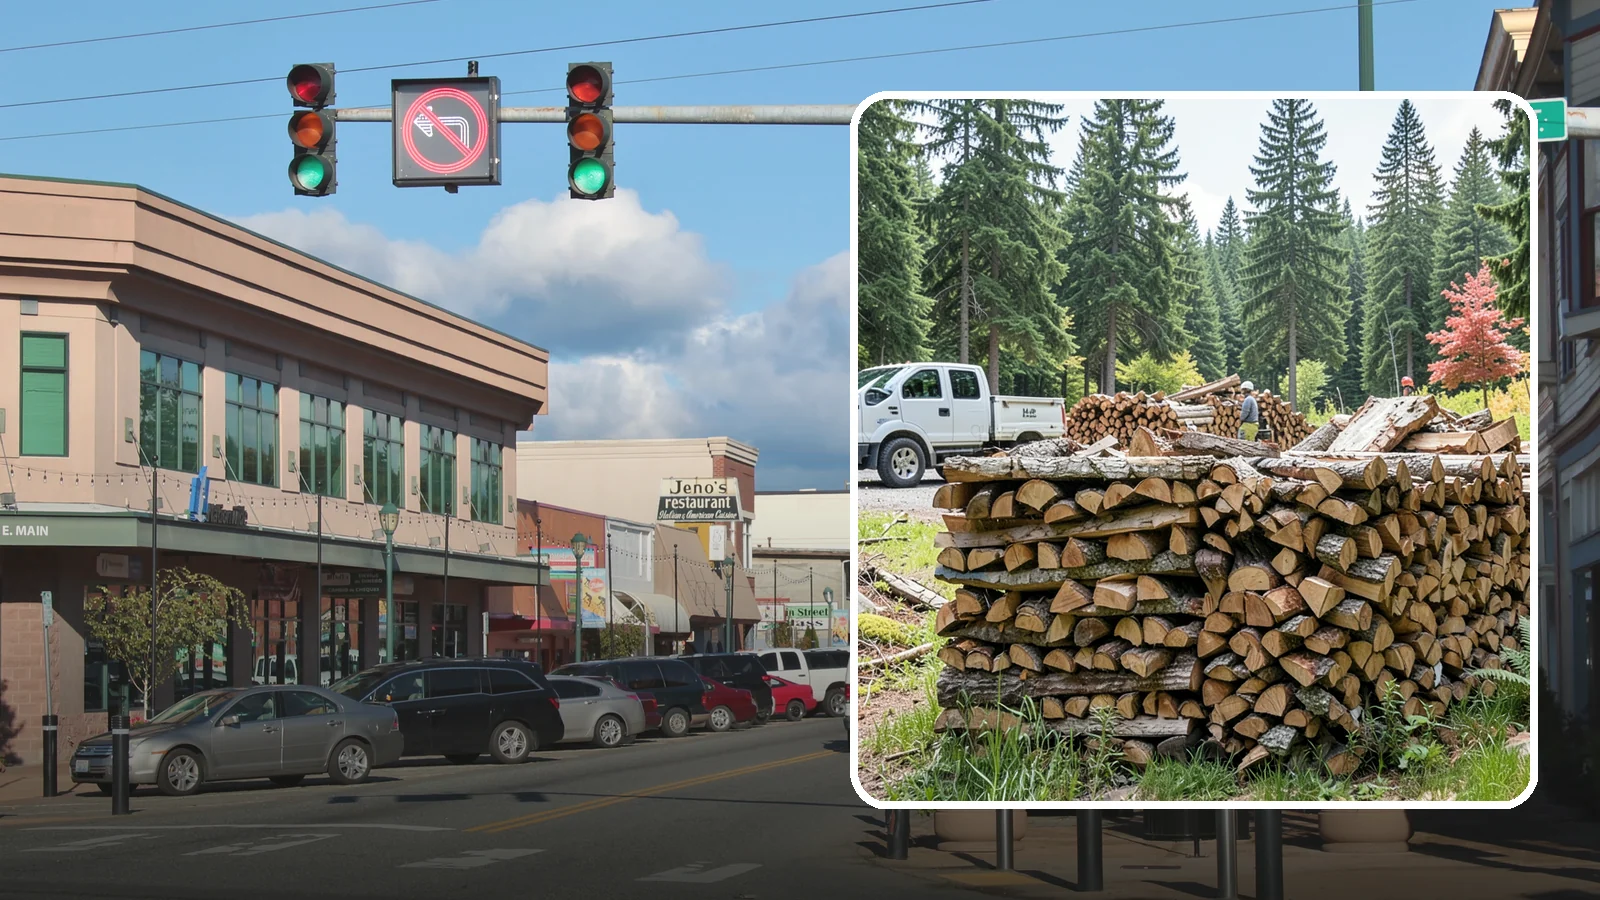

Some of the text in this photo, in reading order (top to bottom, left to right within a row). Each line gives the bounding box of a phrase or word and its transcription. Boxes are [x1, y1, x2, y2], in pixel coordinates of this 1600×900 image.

[670, 480, 727, 494] Jeno's
[665, 496, 731, 509] restaurant
[658, 510, 681, 519] Italian
[686, 510, 714, 519] American
[715, 509, 737, 519] Cuisine
[2, 525, 49, 536] E. MAIN
[797, 607, 828, 617] Street
